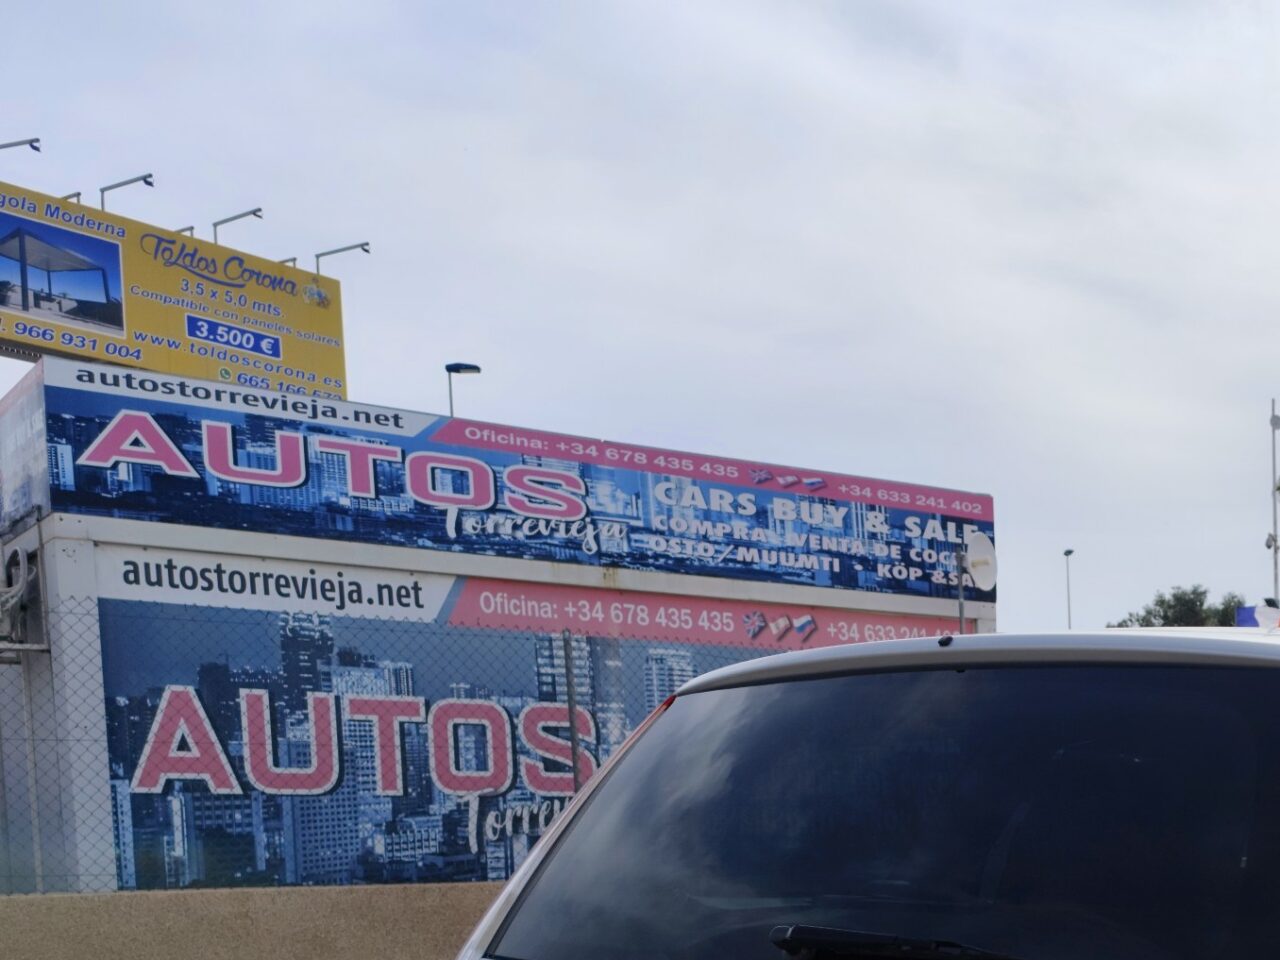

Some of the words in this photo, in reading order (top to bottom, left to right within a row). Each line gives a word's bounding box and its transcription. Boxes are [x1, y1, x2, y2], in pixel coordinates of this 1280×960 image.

[45, 203, 126, 238] Moderna
[140, 233, 218, 277] Toldos
[224, 255, 299, 296] Corona
[130, 285, 210, 312] Compatible
[214, 309, 238, 321] con
[243, 316, 292, 335] paneles
[296, 329, 341, 347] solares
[210, 289, 218, 299] x
[14, 321, 55, 342] 966
[61, 332, 98, 351] 931
[105, 342, 142, 361] 004
[134, 330, 343, 389] www.toldoscorona.es
[195, 320, 255, 348] 3.500
[260, 337, 275, 355] €
[76, 368, 405, 430] autostorrevieja.net
[237, 372, 270, 390] 665
[74, 408, 588, 522] AUTOS
[464, 427, 549, 450] Oficina:
[556, 441, 599, 457] +34
[605, 447, 648, 464] 678
[653, 455, 694, 472] 435
[700, 462, 739, 478] 435
[838, 484, 872, 498] +34
[877, 490, 910, 504] 633
[915, 495, 947, 510] 241
[951, 500, 983, 514] 402
[440, 503, 628, 555] Torrevieja
[653, 481, 757, 516] CARS
[773, 496, 850, 528] BUY
[864, 510, 890, 534] &
[653, 514, 767, 543] COMPRA
[790, 532, 865, 557] VENTA
[872, 543, 902, 560] DE
[122, 558, 425, 610] autostorrevieja.net
[877, 563, 923, 581] KÖP
[479, 591, 558, 619] Oficina:
[564, 600, 604, 622] +34
[610, 603, 649, 626] 678
[655, 606, 693, 630] 435
[698, 609, 735, 633] 435
[827, 621, 859, 641] +34
[864, 624, 896, 641] 633
[130, 684, 599, 796] AUTOS
